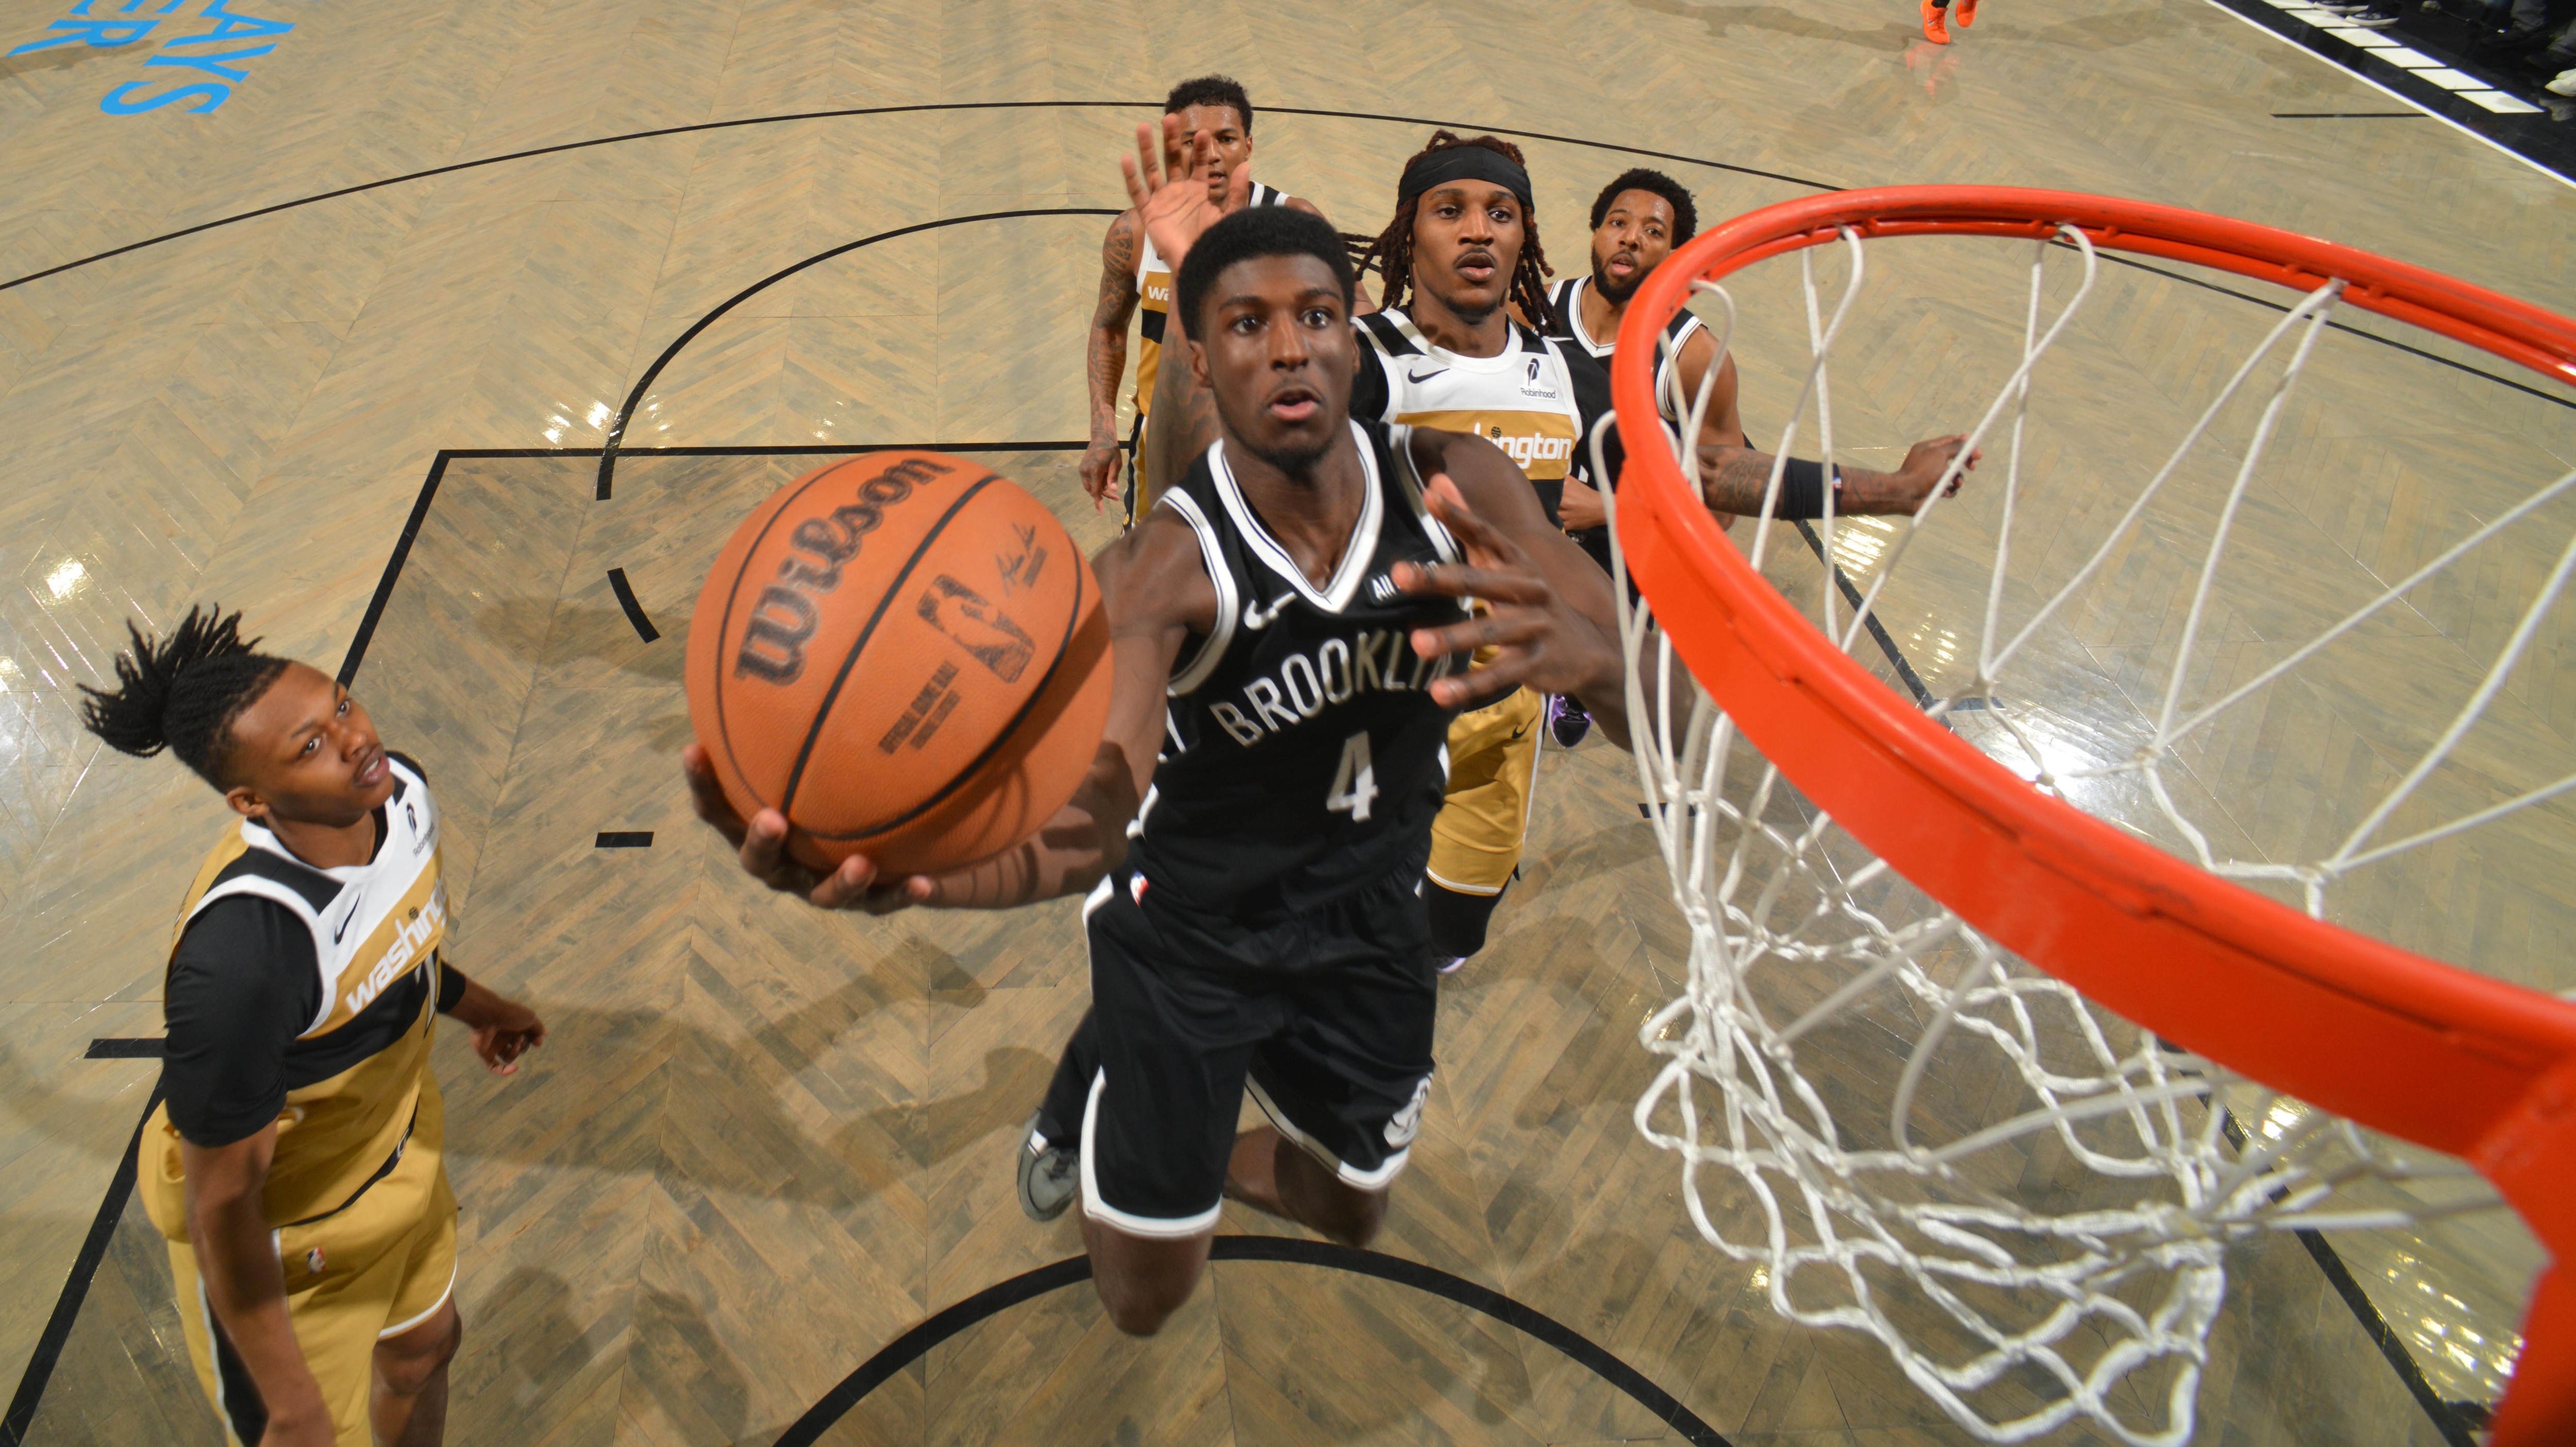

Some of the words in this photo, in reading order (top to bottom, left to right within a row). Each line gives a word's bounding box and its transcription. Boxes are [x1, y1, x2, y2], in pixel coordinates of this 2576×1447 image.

[100, 0, 296, 115] AYS
[1520, 387, 1556, 399] Robinhood
[1474, 422, 1572, 469] ington
[733, 458, 956, 686] Wilson
[1326, 730, 1379, 823] 4
